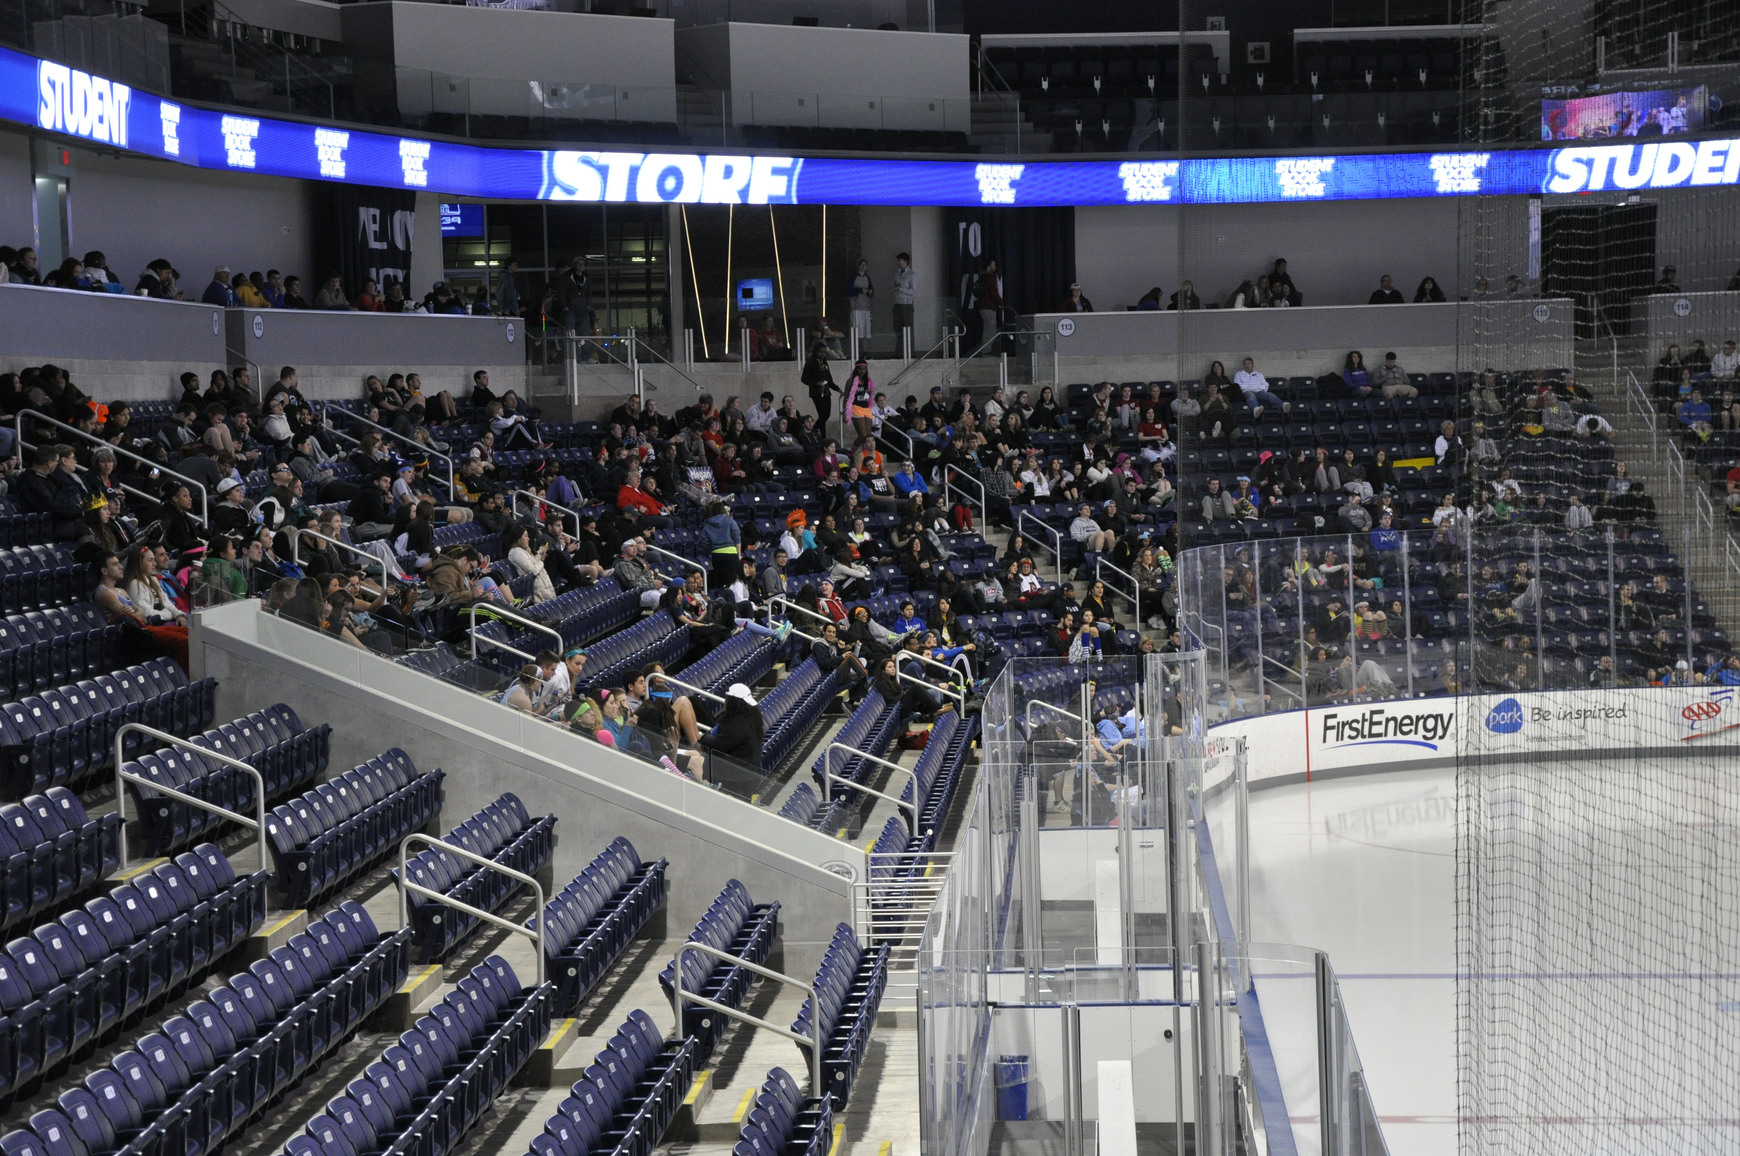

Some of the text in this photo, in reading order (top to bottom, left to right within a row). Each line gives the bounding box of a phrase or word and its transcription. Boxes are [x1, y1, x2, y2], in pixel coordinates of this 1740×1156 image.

[39, 60, 130, 146] STUDENT
[1118, 162, 1179, 178] STUDENT
[1275, 158, 1335, 173] STUDENT
[1126, 187, 1172, 202] STORE
[1059, 323, 1073, 332] 113
[1489, 706, 1522, 729] pork
[1531, 702, 1628, 729] Be inspired
[1322, 708, 1454, 744] FirstEnergy
